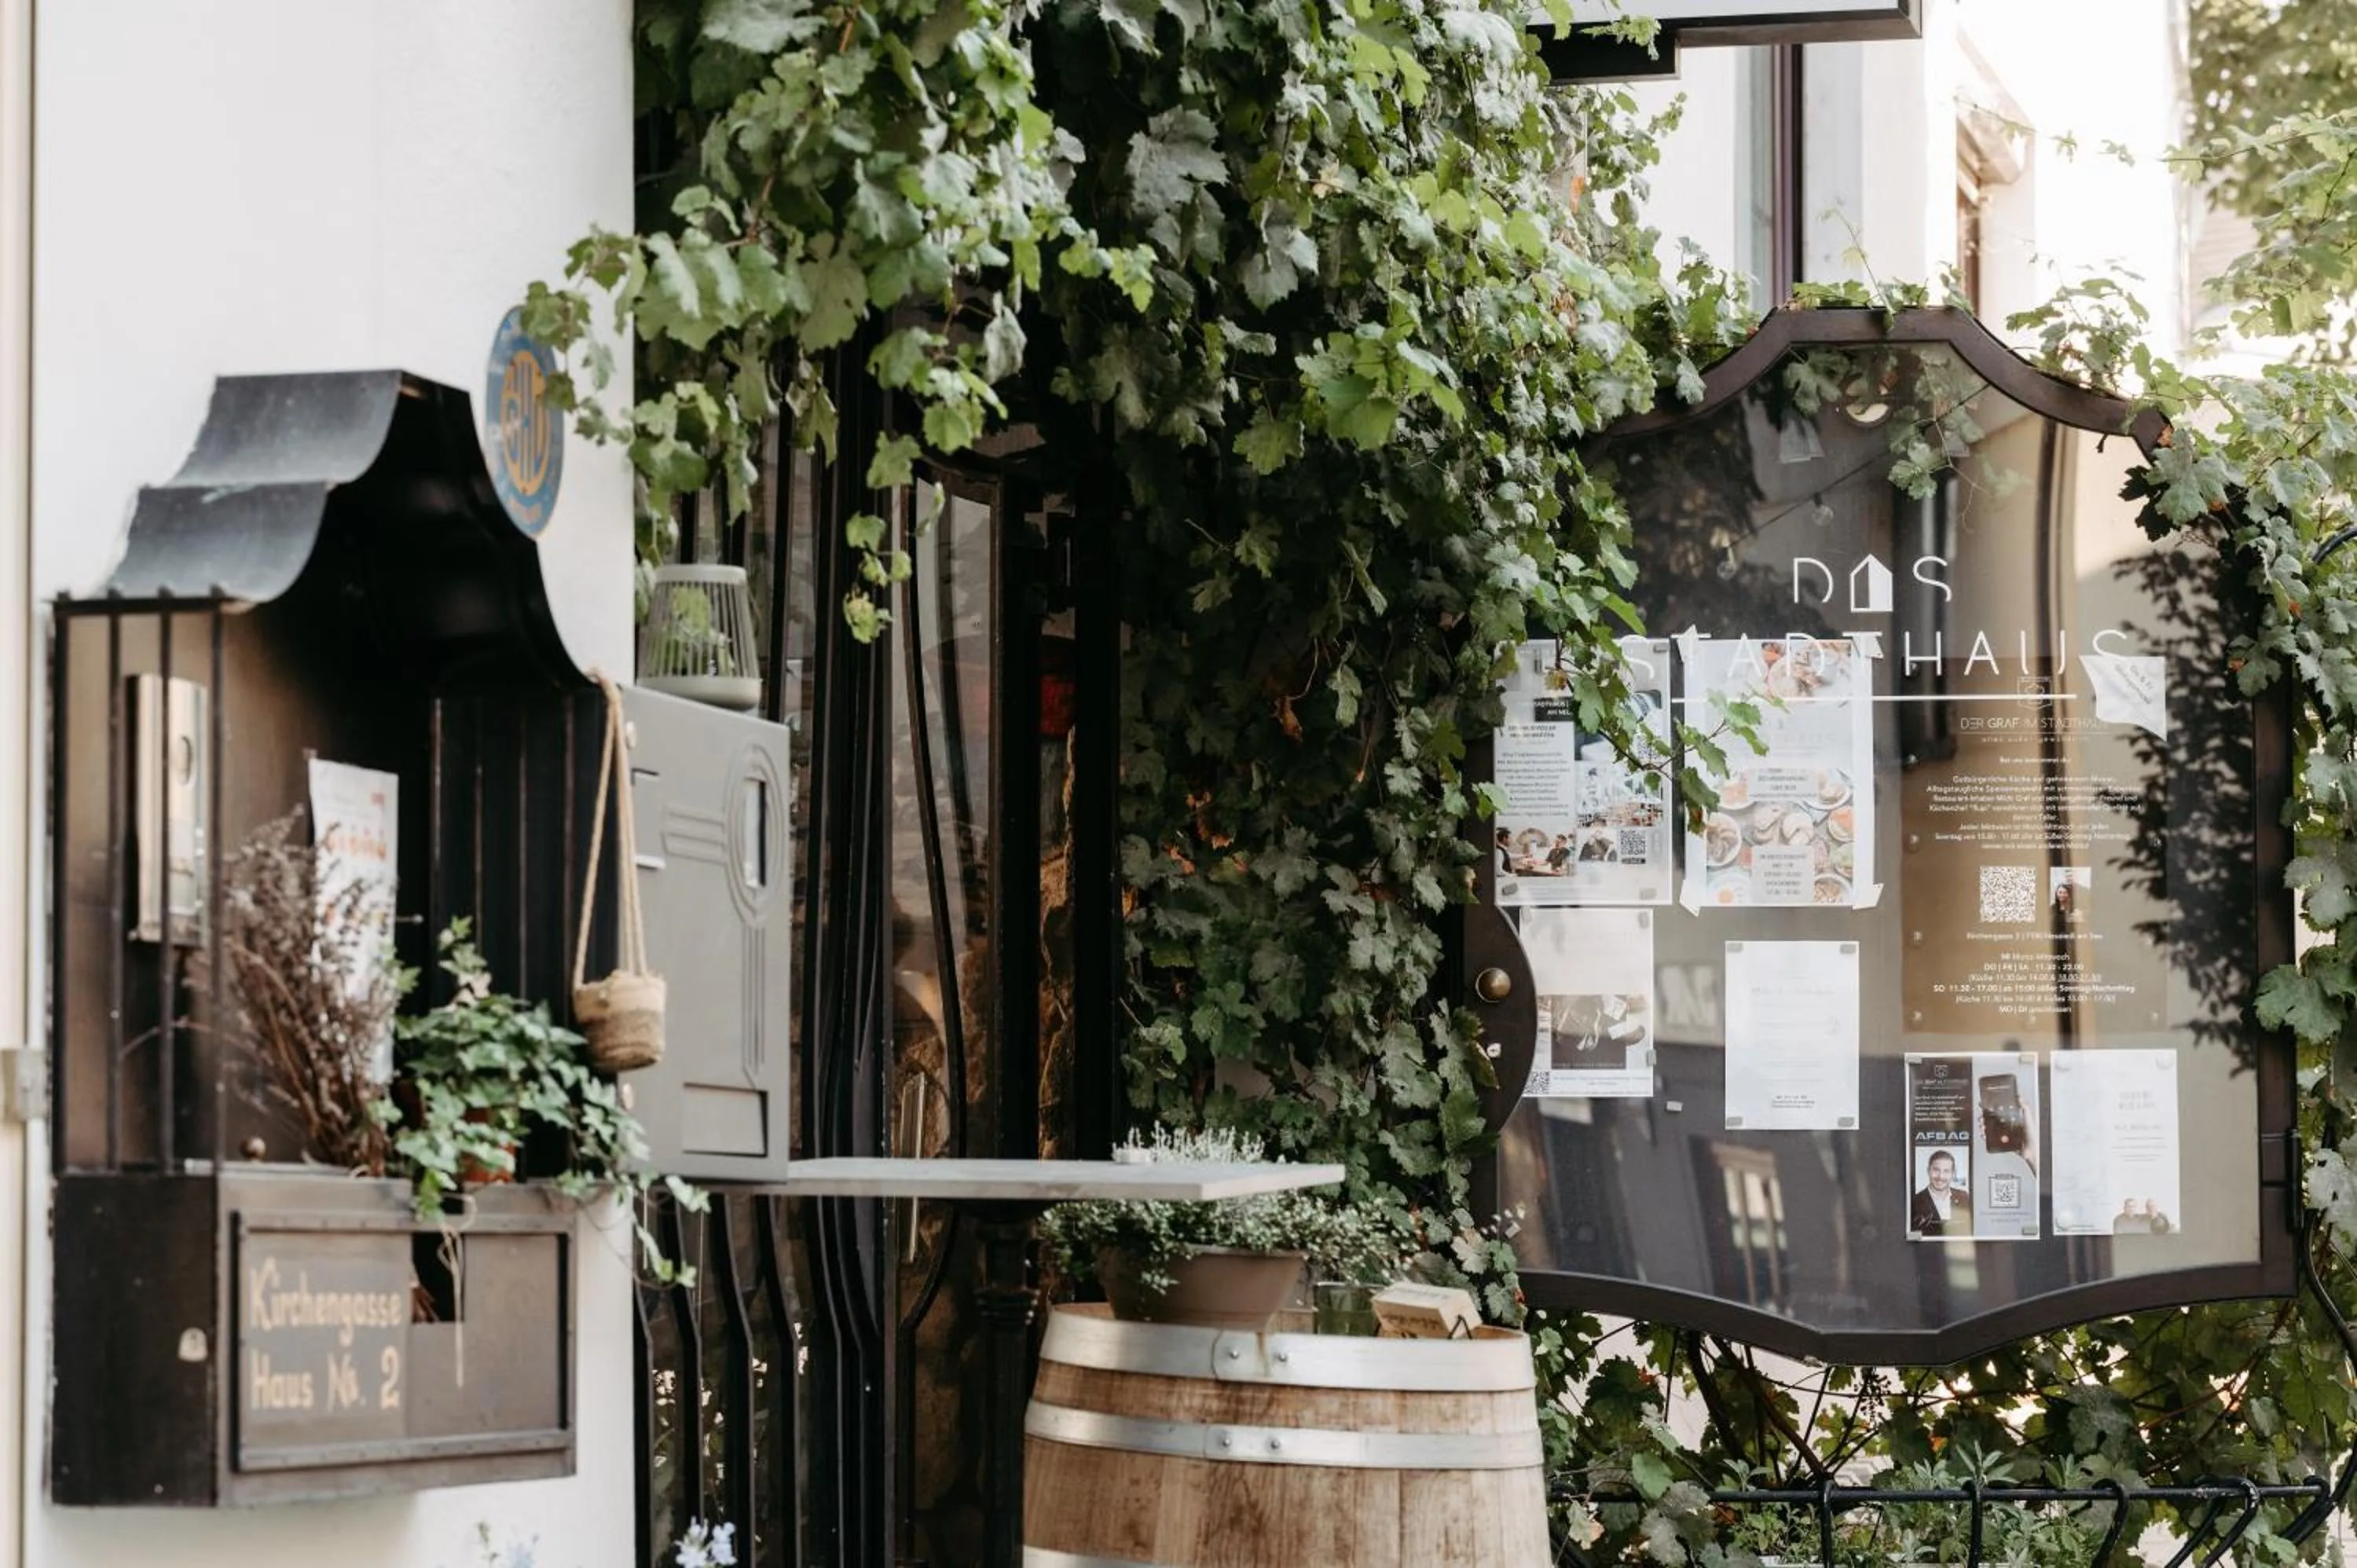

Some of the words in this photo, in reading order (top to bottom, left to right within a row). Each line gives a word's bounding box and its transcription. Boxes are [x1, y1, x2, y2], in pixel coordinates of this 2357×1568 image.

[1961, 717, 1983, 729] DER
[1988, 717, 2020, 729] GRAF
[250, 1255, 402, 1347] Kirchengasse
[251, 1350, 314, 1409] Haus
[380, 1345, 401, 1409] 2
